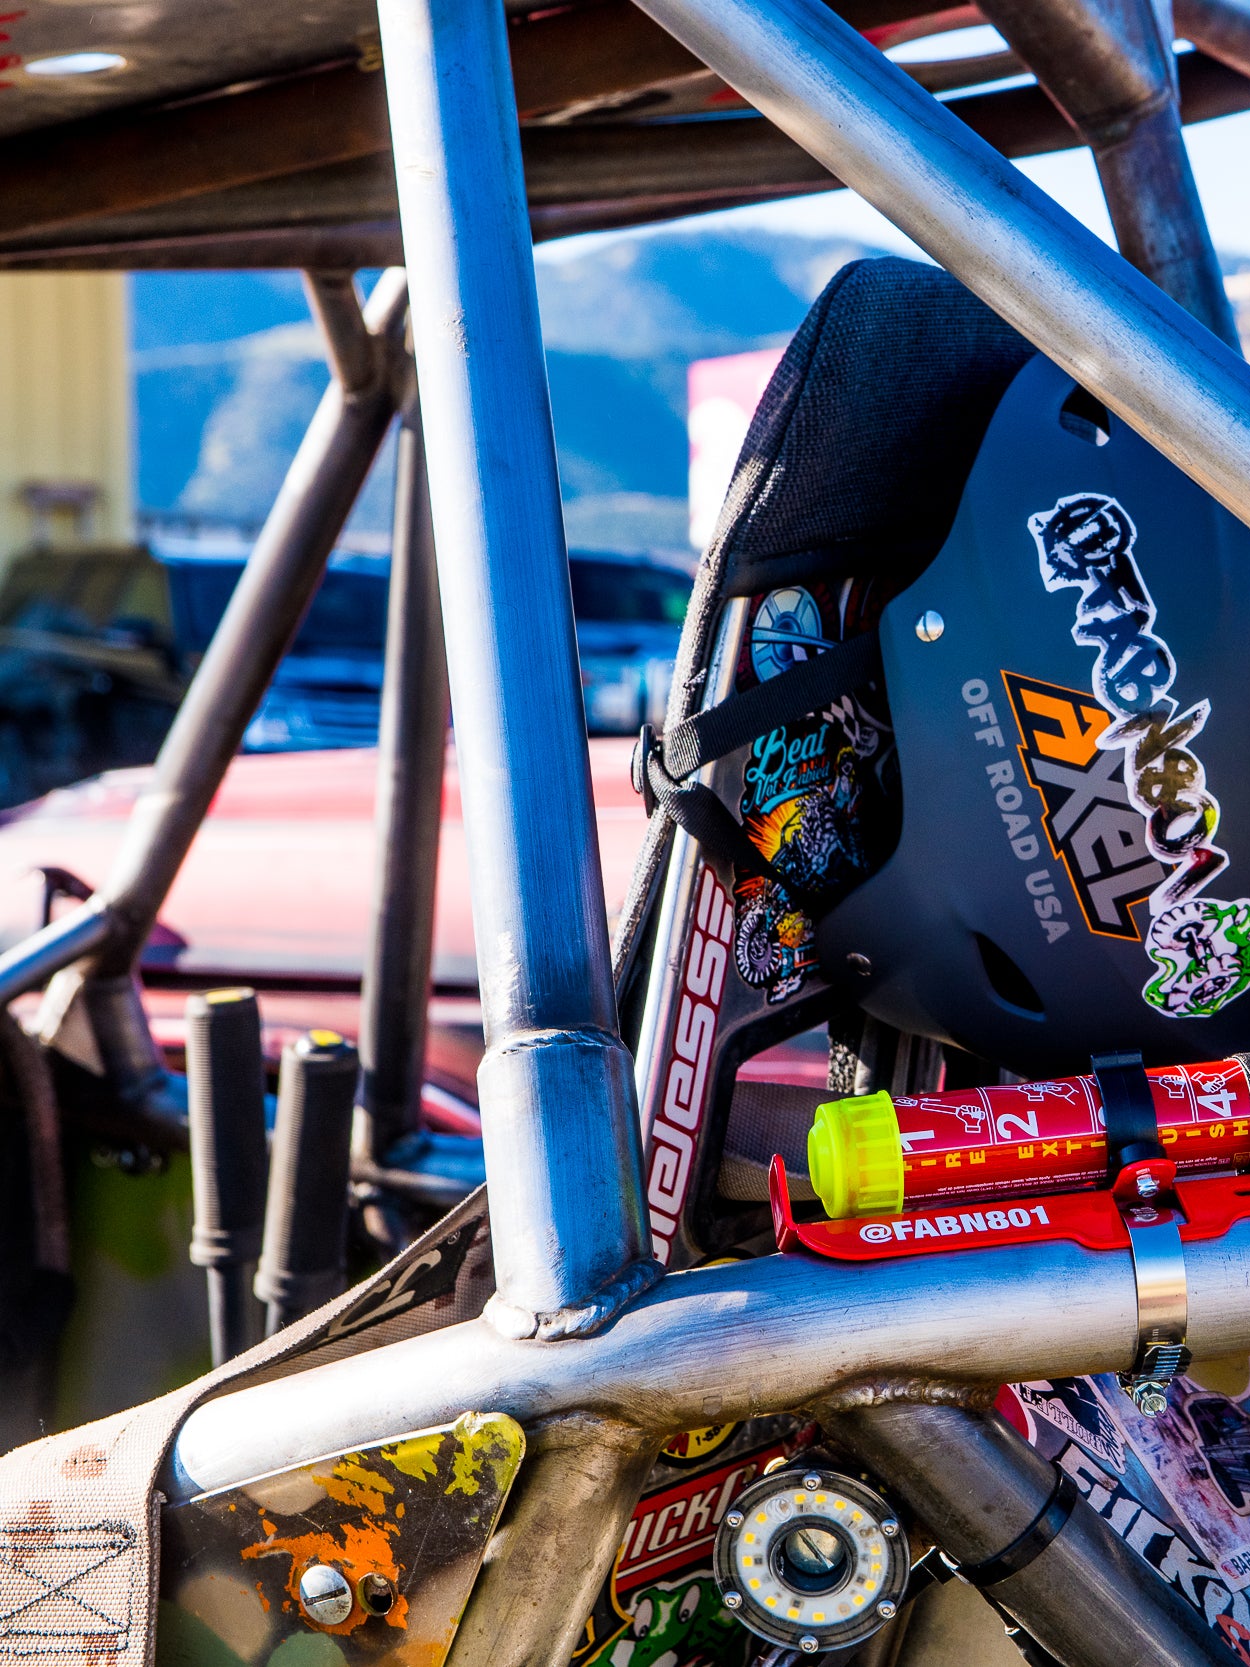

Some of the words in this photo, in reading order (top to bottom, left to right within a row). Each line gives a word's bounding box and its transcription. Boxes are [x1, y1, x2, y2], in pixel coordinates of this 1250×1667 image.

[747, 723, 828, 782] Beat
[961, 678, 1004, 749] OFF
[986, 757, 1039, 861] ROAD
[1024, 869, 1070, 945] USA
[1198, 1089, 1237, 1118] 4
[901, 1130, 934, 1151] 1
[996, 1110, 1040, 1140] 2
[859, 1205, 1050, 1244] @FABN801
